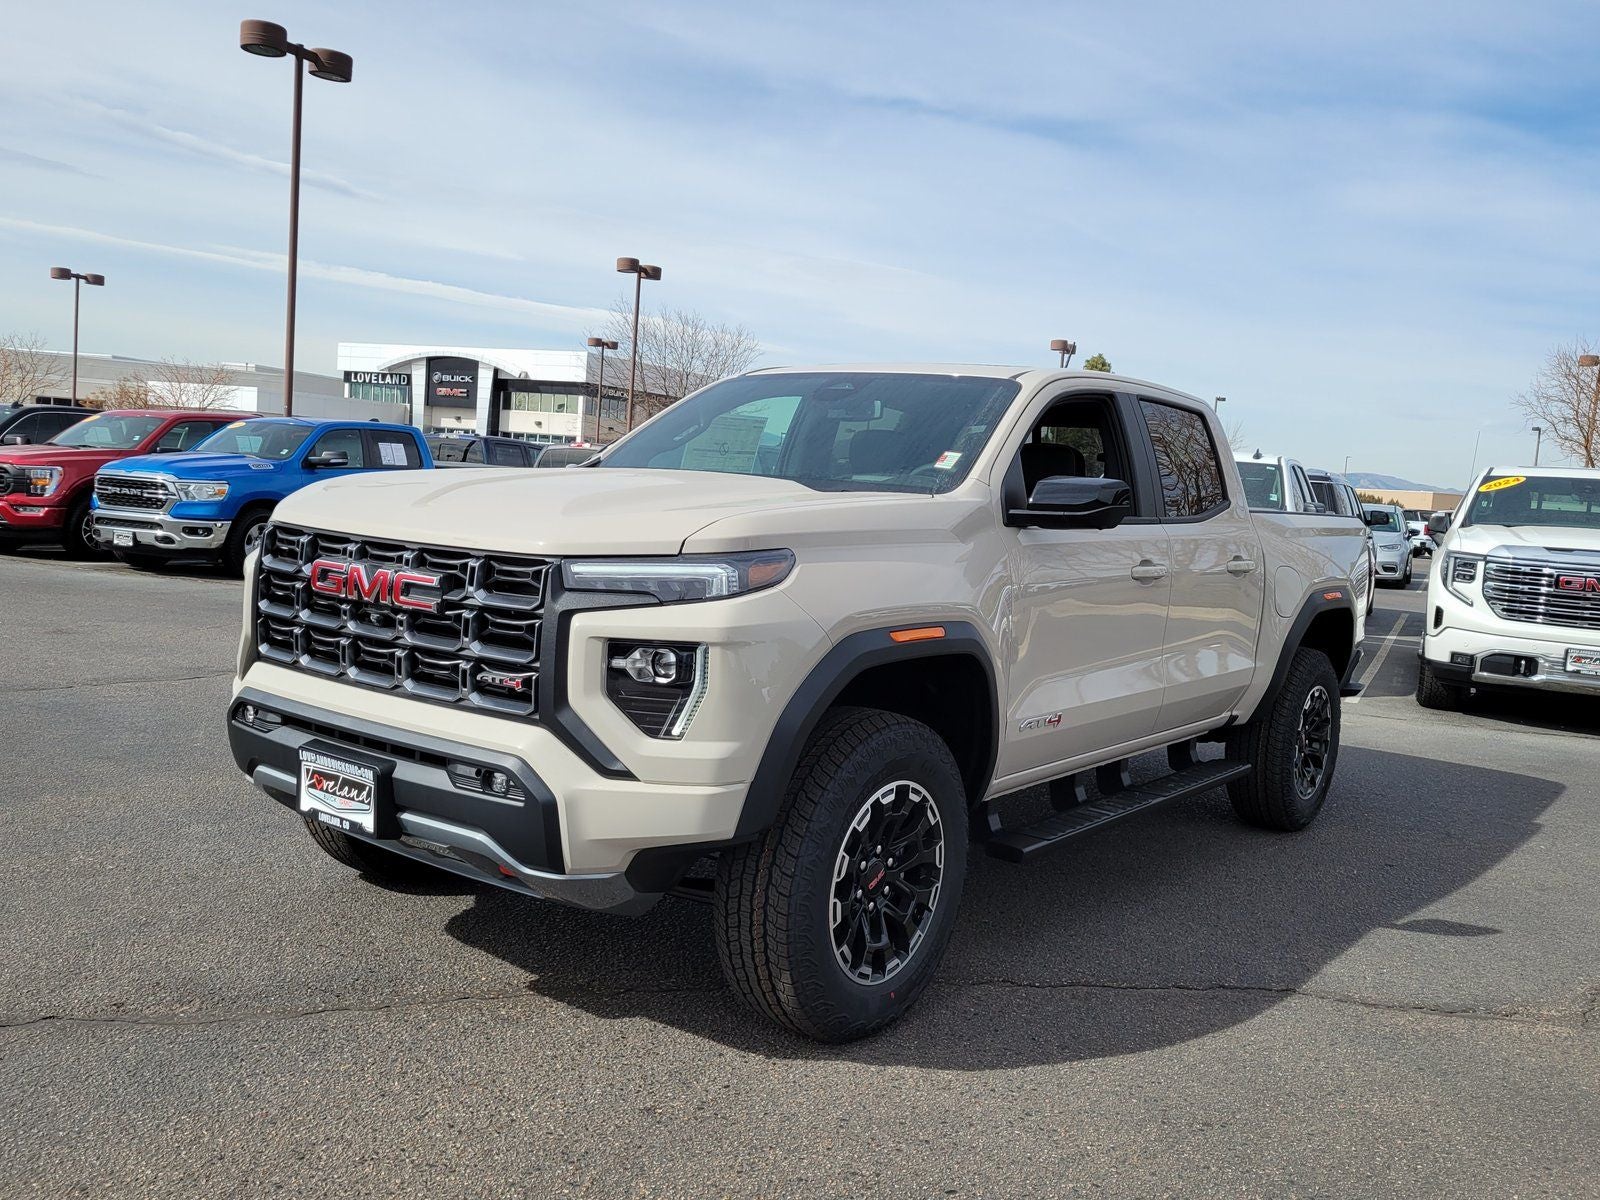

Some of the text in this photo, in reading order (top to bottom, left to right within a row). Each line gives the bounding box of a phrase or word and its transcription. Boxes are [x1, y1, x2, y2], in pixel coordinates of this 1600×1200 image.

[351, 372, 408, 385] LOVELAND
[442, 374, 473, 383] BUICK
[435, 387, 468, 397] GMC
[1485, 477, 1521, 490] 2024
[110, 487, 142, 496] RAM
[311, 559, 440, 612] GMC
[476, 671, 523, 690] AT4
[1018, 712, 1063, 732] AT4
[868, 867, 885, 890] GMC
